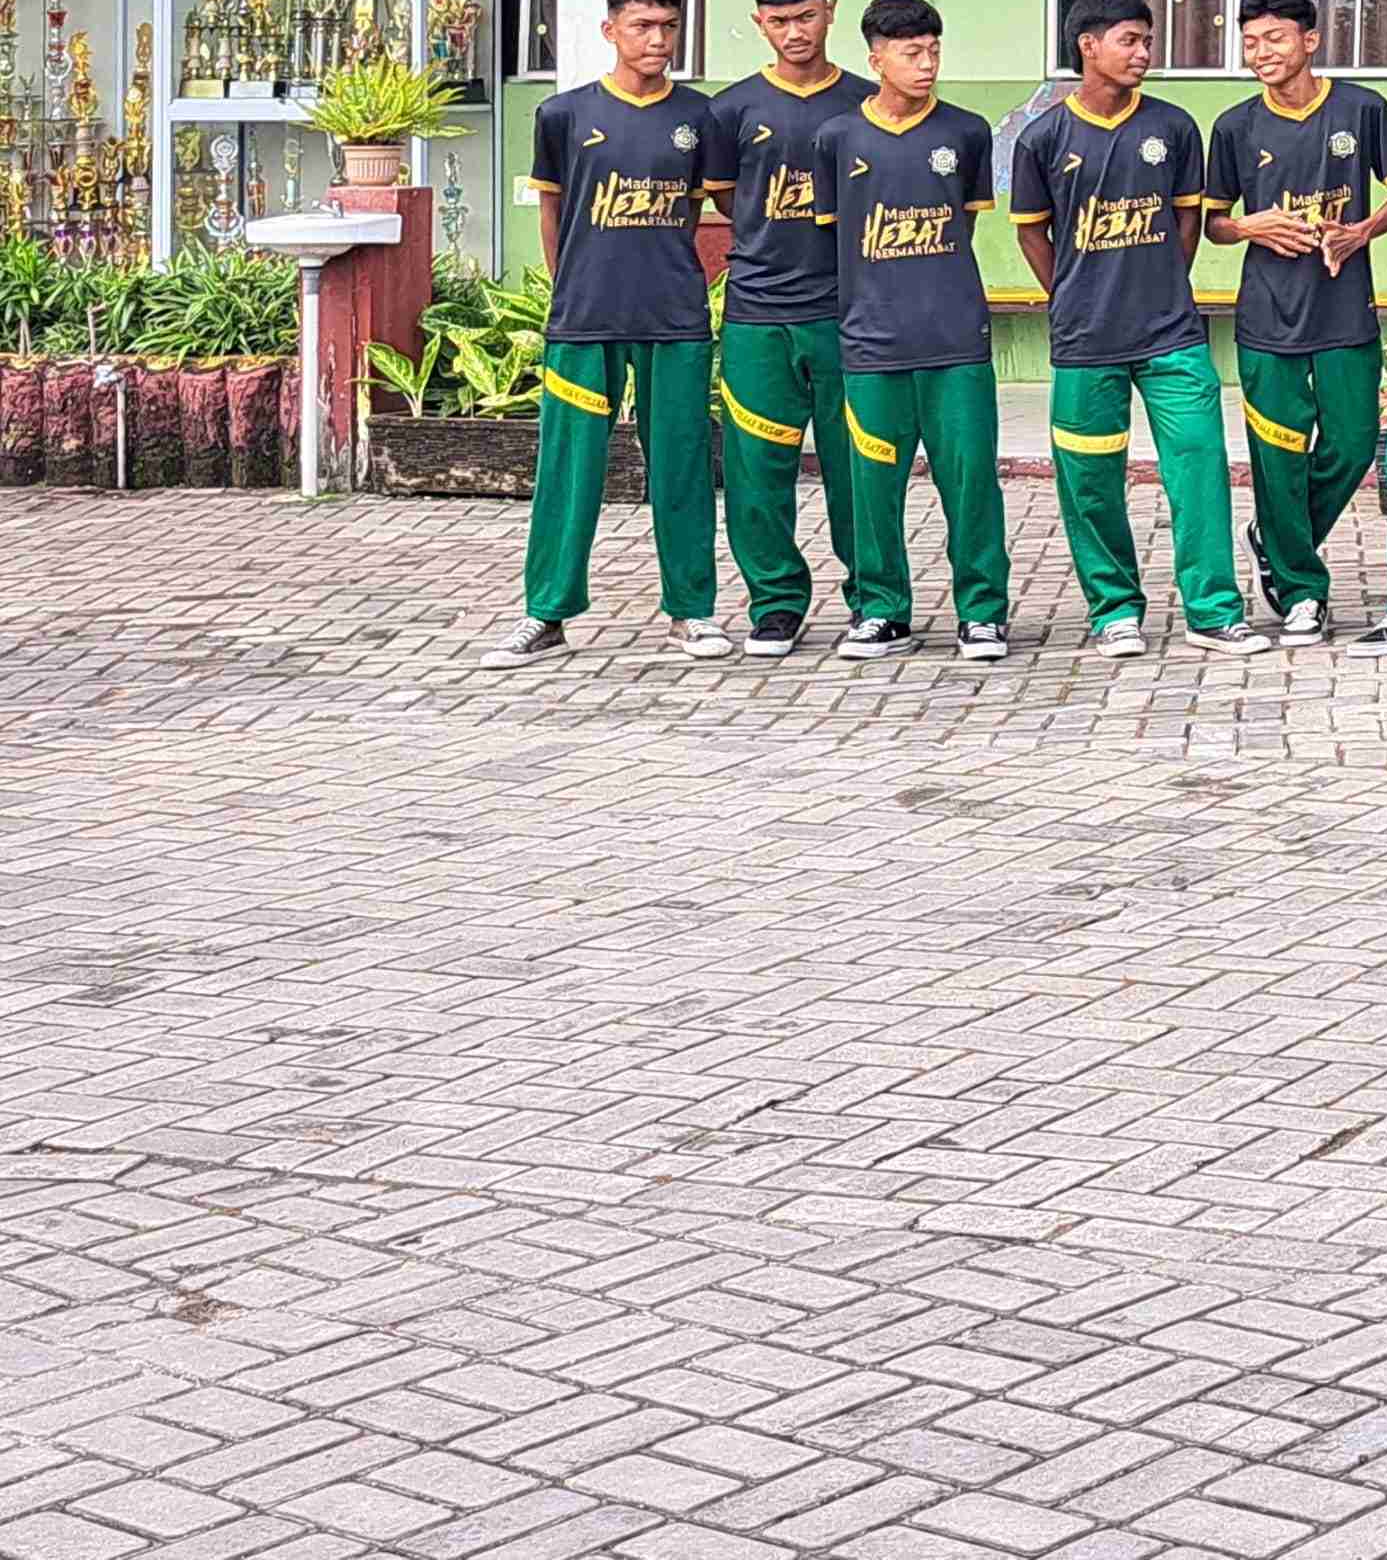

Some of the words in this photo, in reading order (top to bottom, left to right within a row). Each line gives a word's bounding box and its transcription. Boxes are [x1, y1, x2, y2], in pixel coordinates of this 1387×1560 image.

[591, 171, 687, 232] HEBAT
[620, 177, 687, 191] Madrasah
[765, 164, 814, 221] HEB
[884, 203, 952, 221] Madrasah
[861, 202, 953, 262] HEBAT
[1075, 195, 1161, 254] HEBAT
